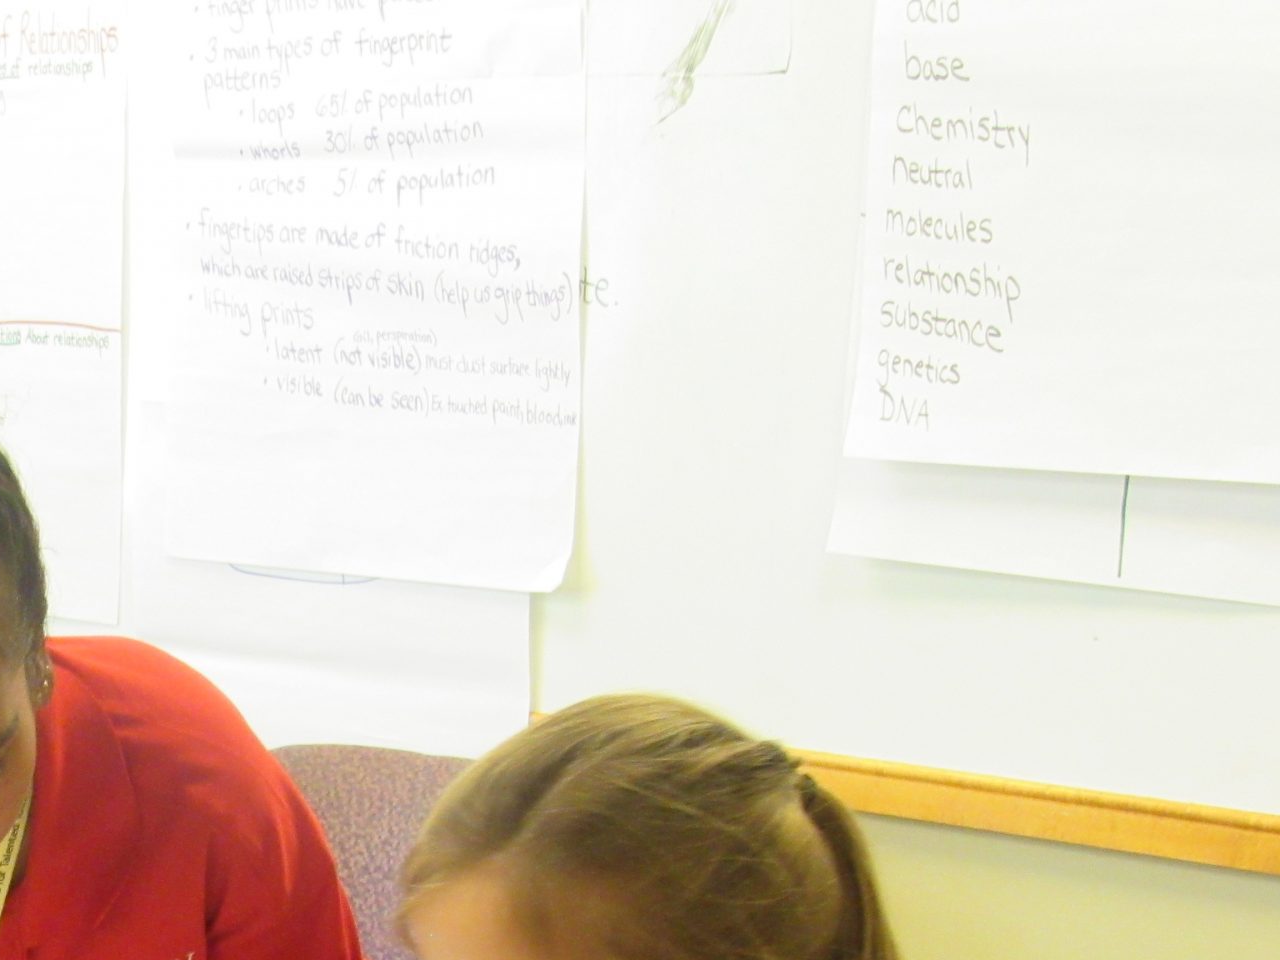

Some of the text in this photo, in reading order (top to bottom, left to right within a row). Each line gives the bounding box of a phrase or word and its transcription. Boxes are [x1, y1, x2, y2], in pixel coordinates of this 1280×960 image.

[906, 0, 961, 24] acid
[20, 6, 120, 79] Relationships
[204, 27, 453, 76] 3 main types of fingerprint
[904, 39, 971, 82] base
[28, 58, 94, 82] relationships
[204, 69, 282, 110] patterns
[252, 98, 296, 136] loops
[354, 89, 373, 115] of
[378, 83, 474, 122] population
[249, 140, 302, 161] whorls
[363, 126, 381, 151] of
[386, 120, 485, 160] population
[249, 174, 306, 193] arches
[367, 169, 387, 195] of
[397, 164, 496, 208] population
[893, 155, 973, 190] neutral
[198, 207, 275, 256] fingertips
[279, 225, 308, 244] are
[315, 225, 361, 250] made
[365, 222, 387, 248] of
[394, 224, 460, 260] friction
[886, 208, 994, 246] molecules
[200, 255, 242, 281] which
[245, 264, 269, 282] are
[272, 263, 315, 288] raised
[319, 267, 363, 307] strips
[365, 268, 383, 293] of
[386, 271, 426, 303] skin
[473, 285, 492, 304] us
[494, 283, 525, 326] grip
[883, 254, 1020, 324] relationship
[204, 286, 315, 339] lifting prints
[53, 330, 111, 360] relationships
[275, 337, 323, 366] latent
[333, 336, 363, 367] (not
[367, 344, 423, 377] visible)
[425, 353, 452, 373] must
[456, 354, 487, 377] dust
[535, 357, 572, 393] lightly
[877, 348, 961, 388] genetics
[277, 373, 324, 398] visible
[368, 383, 385, 409] be
[877, 383, 930, 432] DNA
